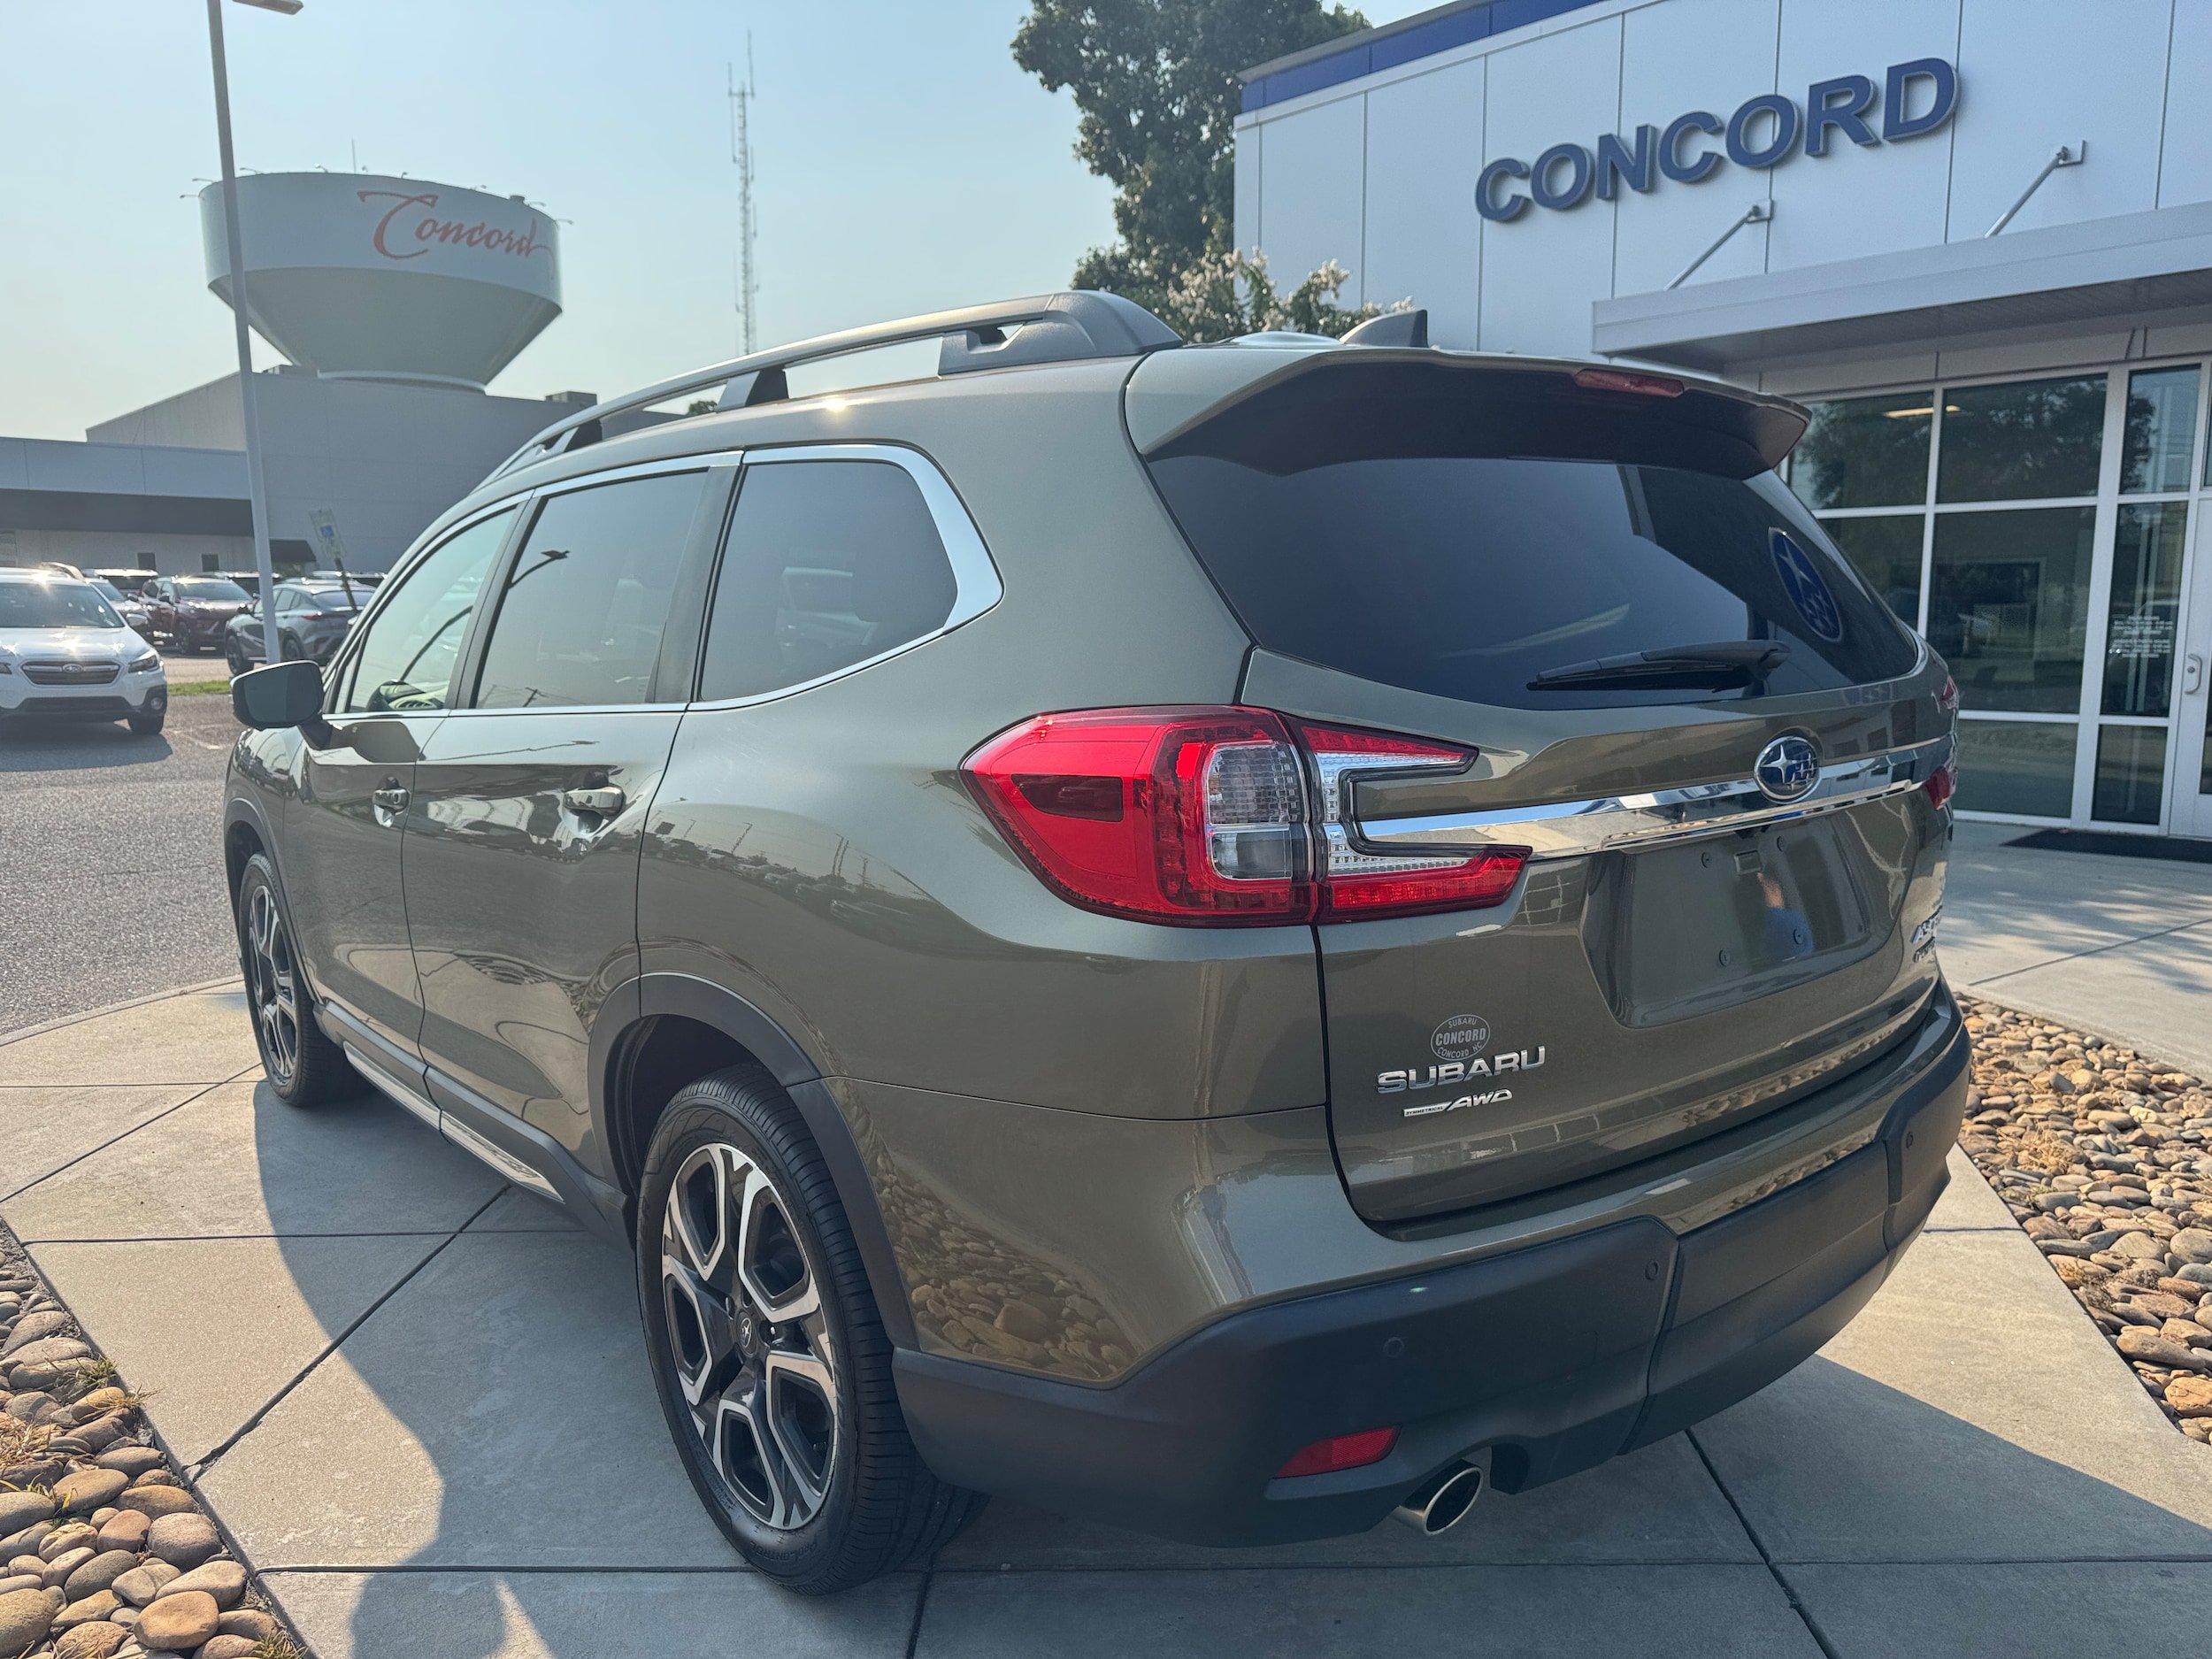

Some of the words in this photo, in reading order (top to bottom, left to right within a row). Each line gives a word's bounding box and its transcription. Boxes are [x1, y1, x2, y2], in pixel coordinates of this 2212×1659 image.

[1475, 58, 1961, 223] CONCORD
[357, 190, 555, 278] Concord
[1448, 1017, 1478, 1029] SUBARU
[1435, 1027, 1486, 1047] CONCORD
[1437, 1046, 1470, 1059] CONCORD
[1471, 1041, 1483, 1052] NC
[1377, 1045, 1546, 1094] SUBARU
[1447, 1088, 1513, 1111] AWD
